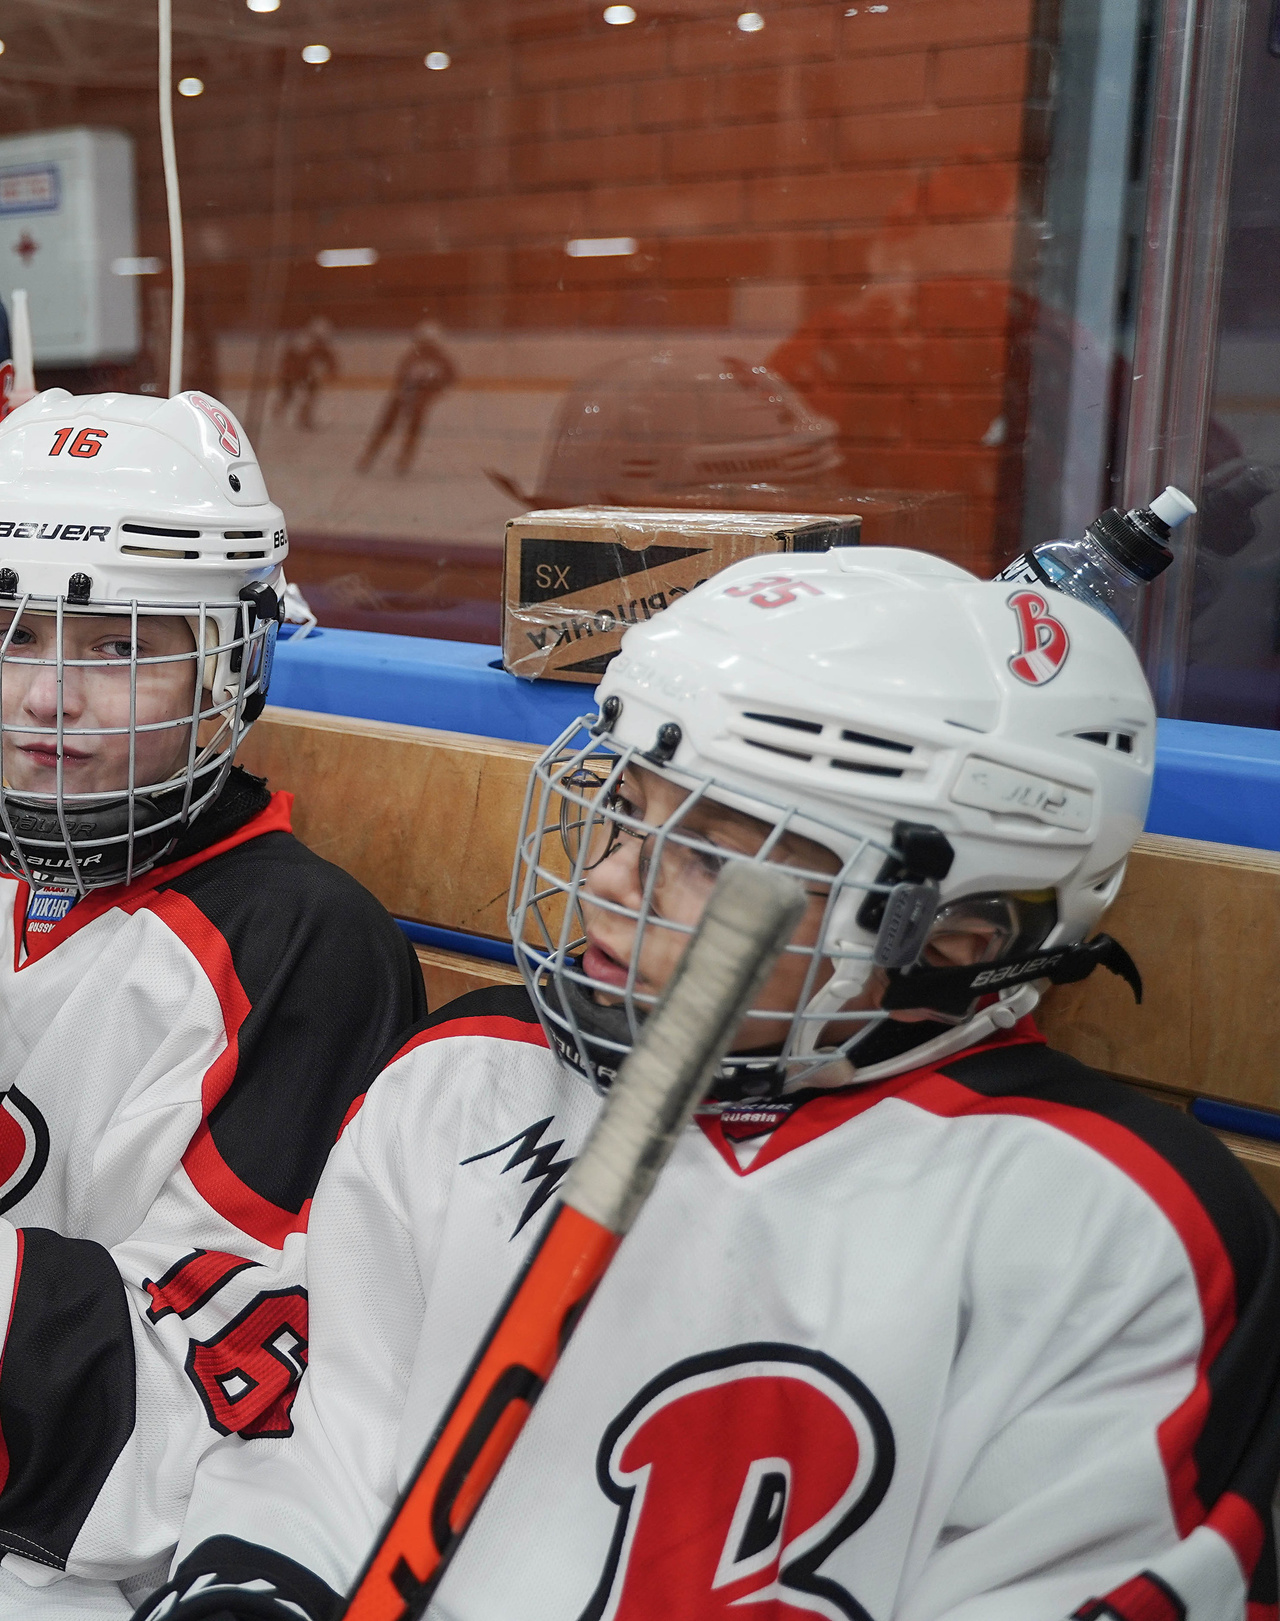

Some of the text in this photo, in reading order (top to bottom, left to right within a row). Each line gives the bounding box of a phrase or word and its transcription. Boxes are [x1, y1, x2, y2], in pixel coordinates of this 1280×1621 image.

[48, 427, 109, 459] 16
[273, 529, 287, 549] BA
[723, 576, 825, 610] 35
[30, 897, 70, 918] VIKHR
[969, 952, 1064, 988] BAUER
[549, 1027, 618, 1082] AUR
[142, 1248, 309, 1442] 16
